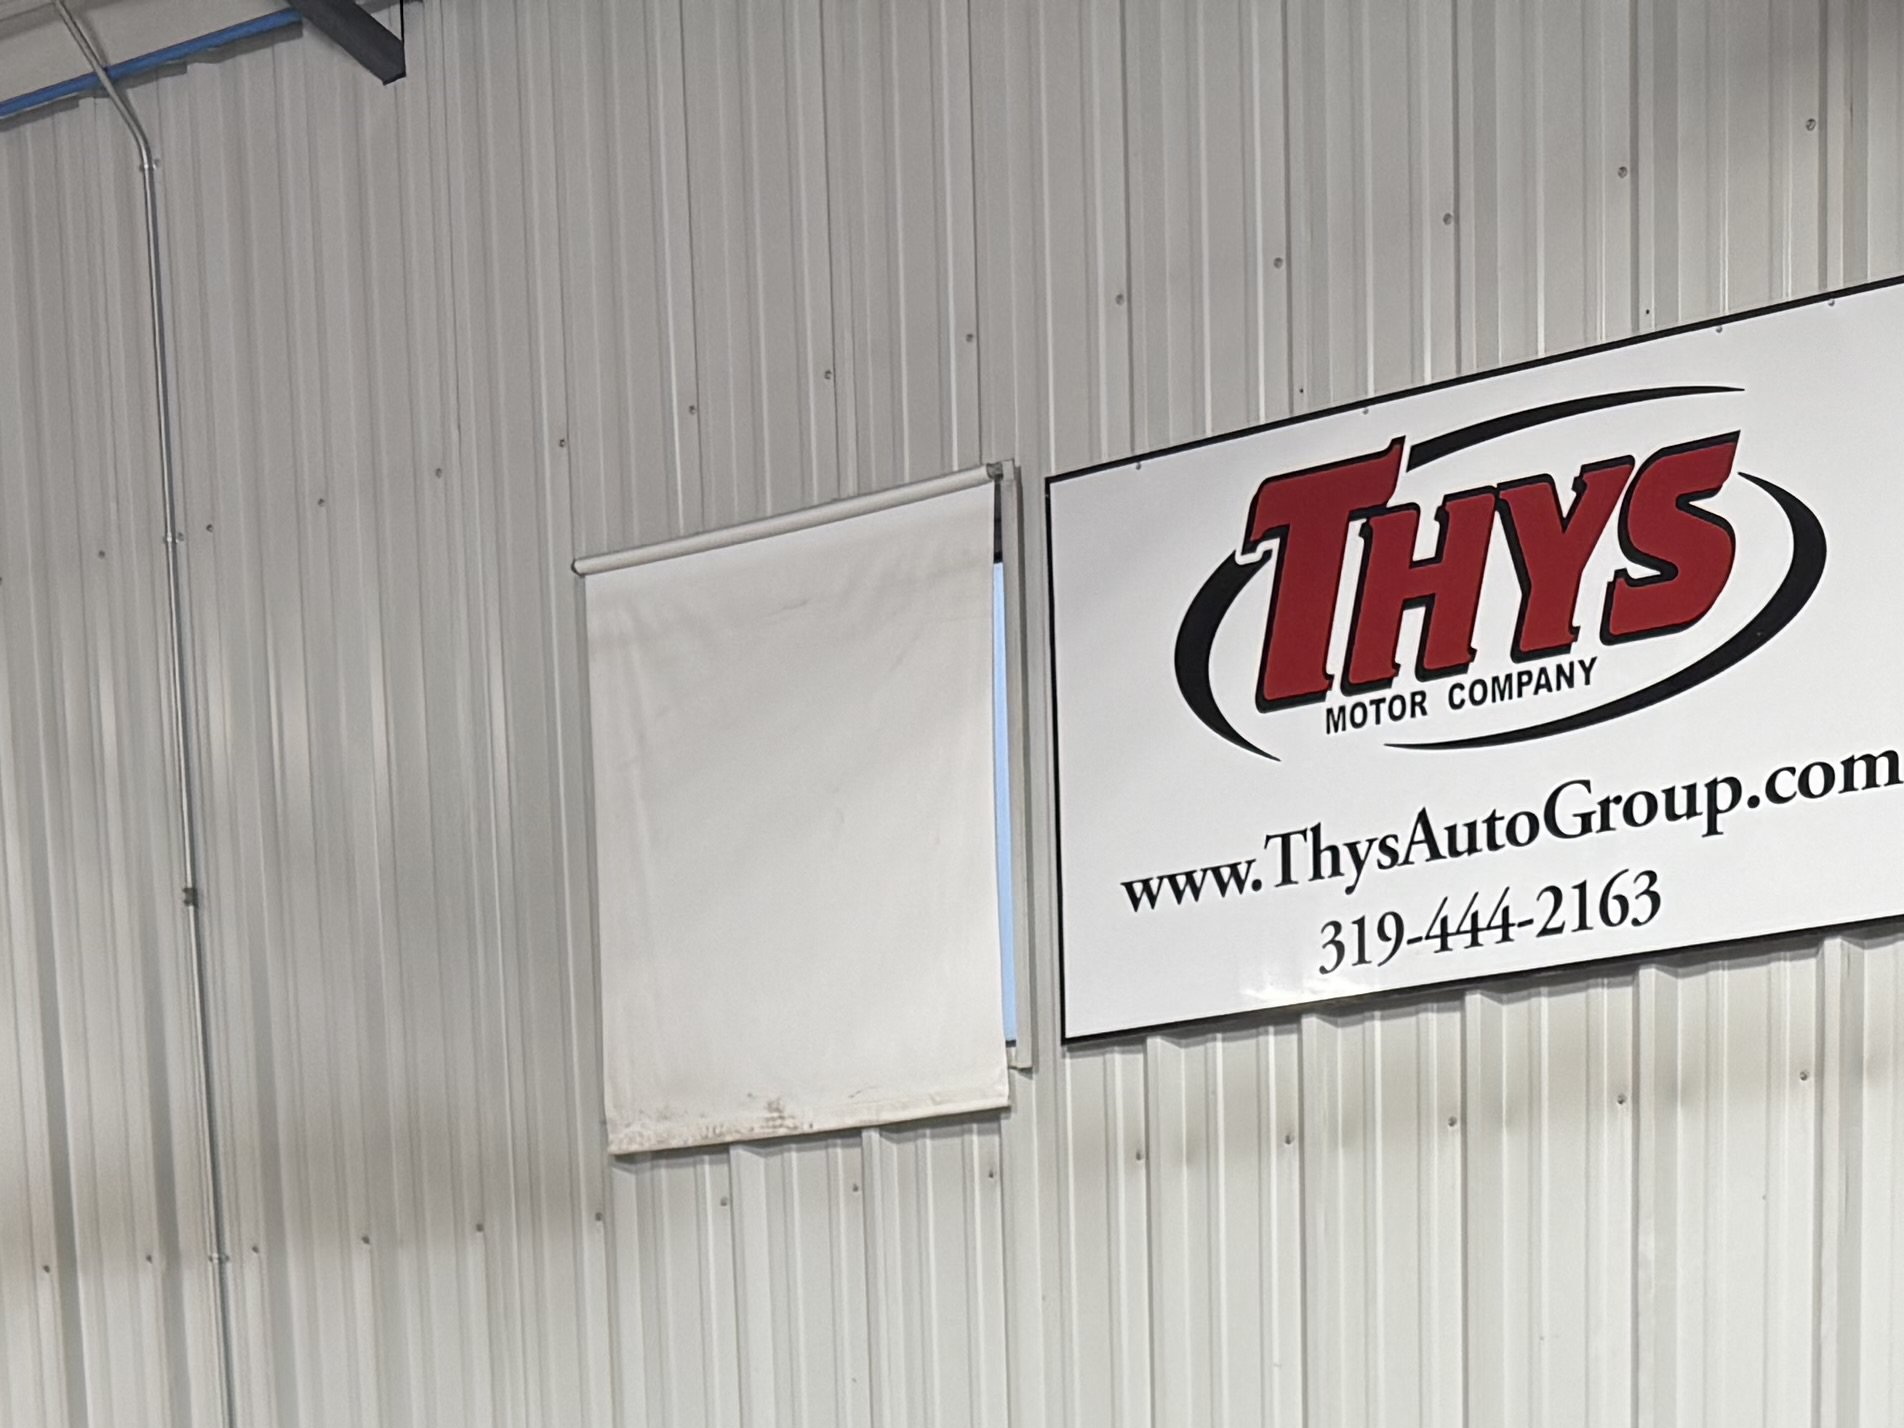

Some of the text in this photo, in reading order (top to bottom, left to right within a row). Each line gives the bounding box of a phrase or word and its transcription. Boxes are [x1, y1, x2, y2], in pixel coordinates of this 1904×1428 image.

[1238, 429, 1742, 714] THYS
[1325, 656, 1598, 735] MOTOR COMPANY
[1120, 748, 1904, 913] www.ThysAutoGroup.com
[1318, 867, 1662, 976] 319-444-2163
